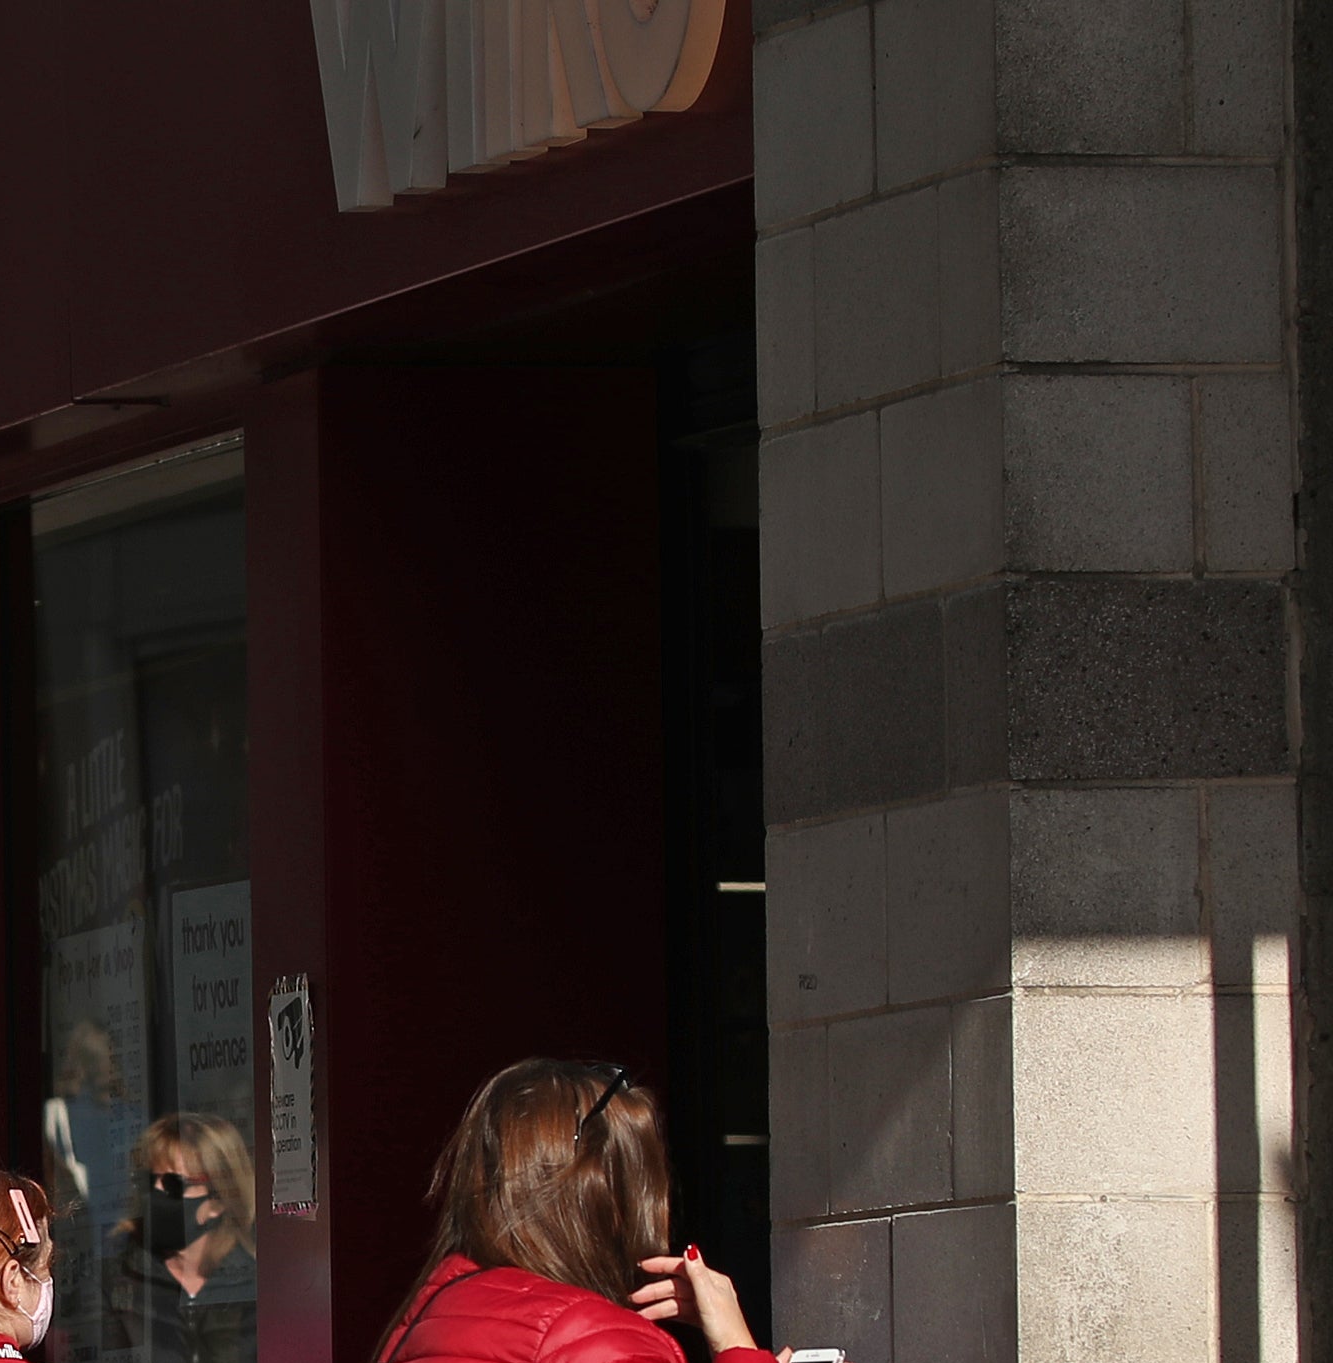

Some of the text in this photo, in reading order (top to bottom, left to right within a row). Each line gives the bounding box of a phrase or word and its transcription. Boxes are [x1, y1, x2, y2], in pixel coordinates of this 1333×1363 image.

[66, 728, 125, 840] A LITTLE
[101, 806, 146, 909] MAGIC
[152, 783, 184, 870] FOR
[182, 912, 244, 957] thank you
[192, 974, 239, 1019] for your
[189, 1031, 247, 1081] patience
